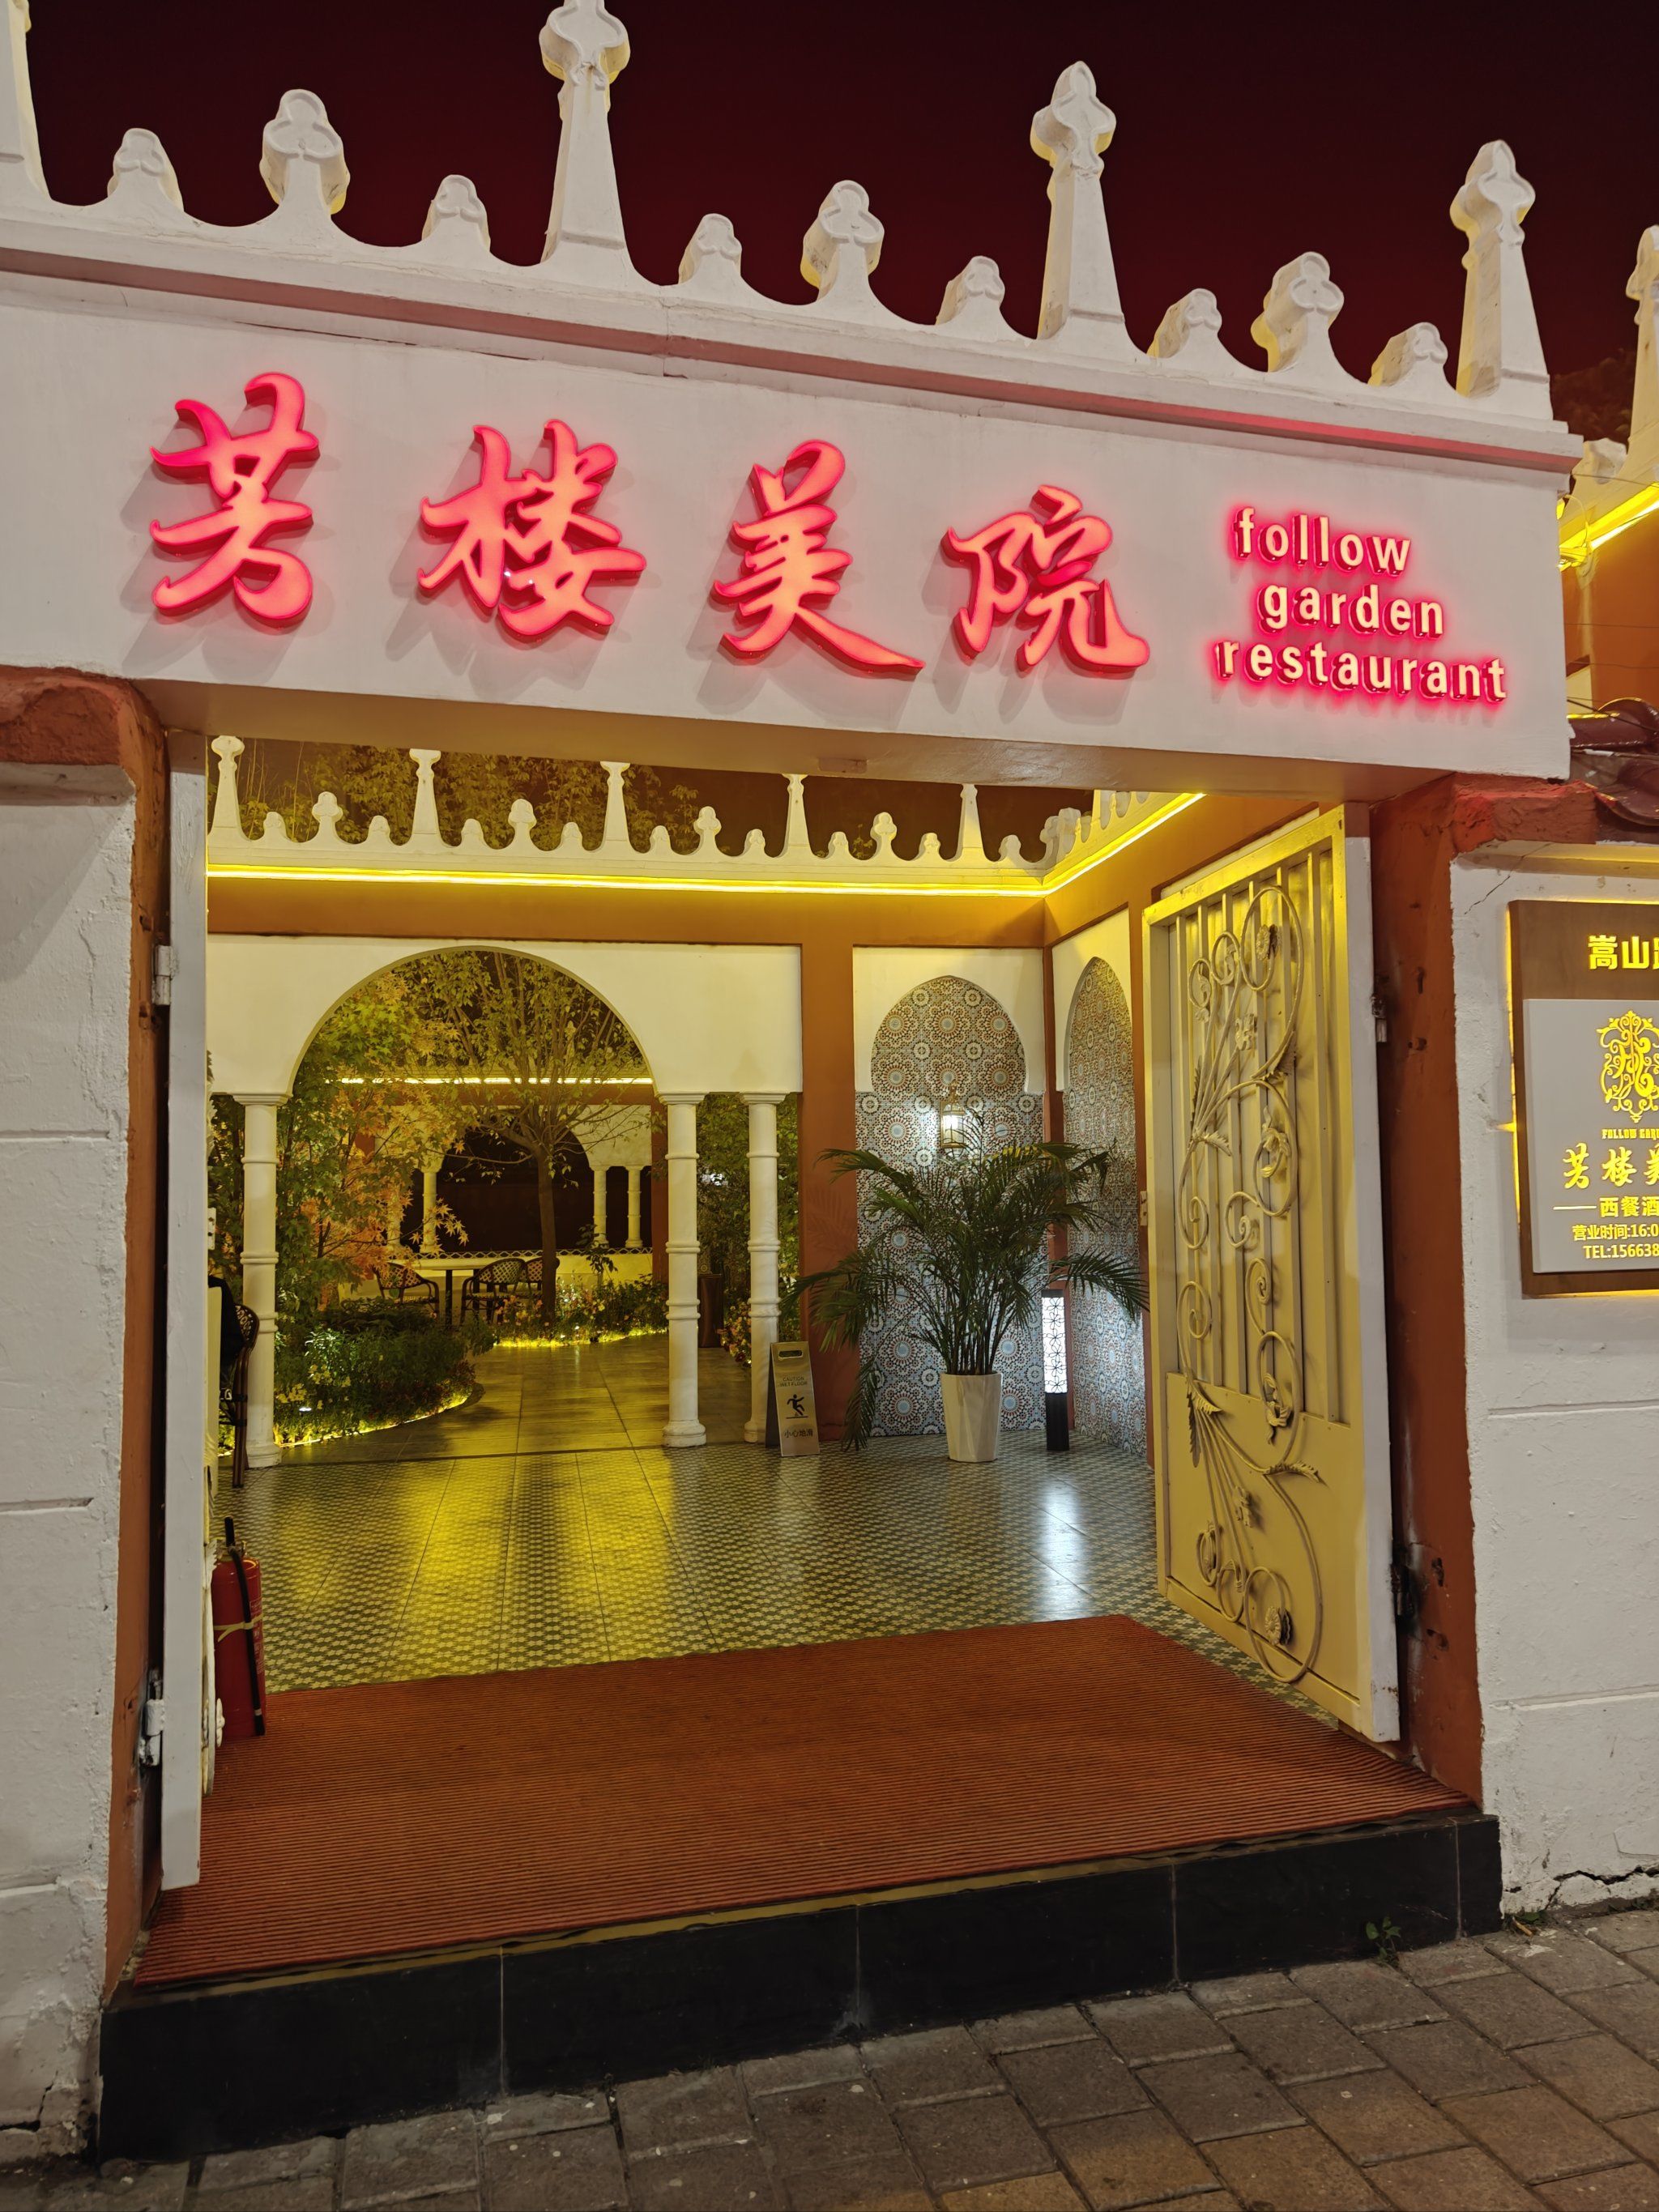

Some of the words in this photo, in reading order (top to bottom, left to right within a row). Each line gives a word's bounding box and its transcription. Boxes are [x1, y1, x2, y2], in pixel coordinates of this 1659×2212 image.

[151, 371, 1150, 674] 芳楼美院
[1234, 506, 1411, 573] follow
[1258, 583, 1444, 638] garden
[1215, 640, 1508, 701] restaurant
[1588, 934, 1659, 970] 嵩山
[1601, 1128, 1636, 1139] FOLLOW
